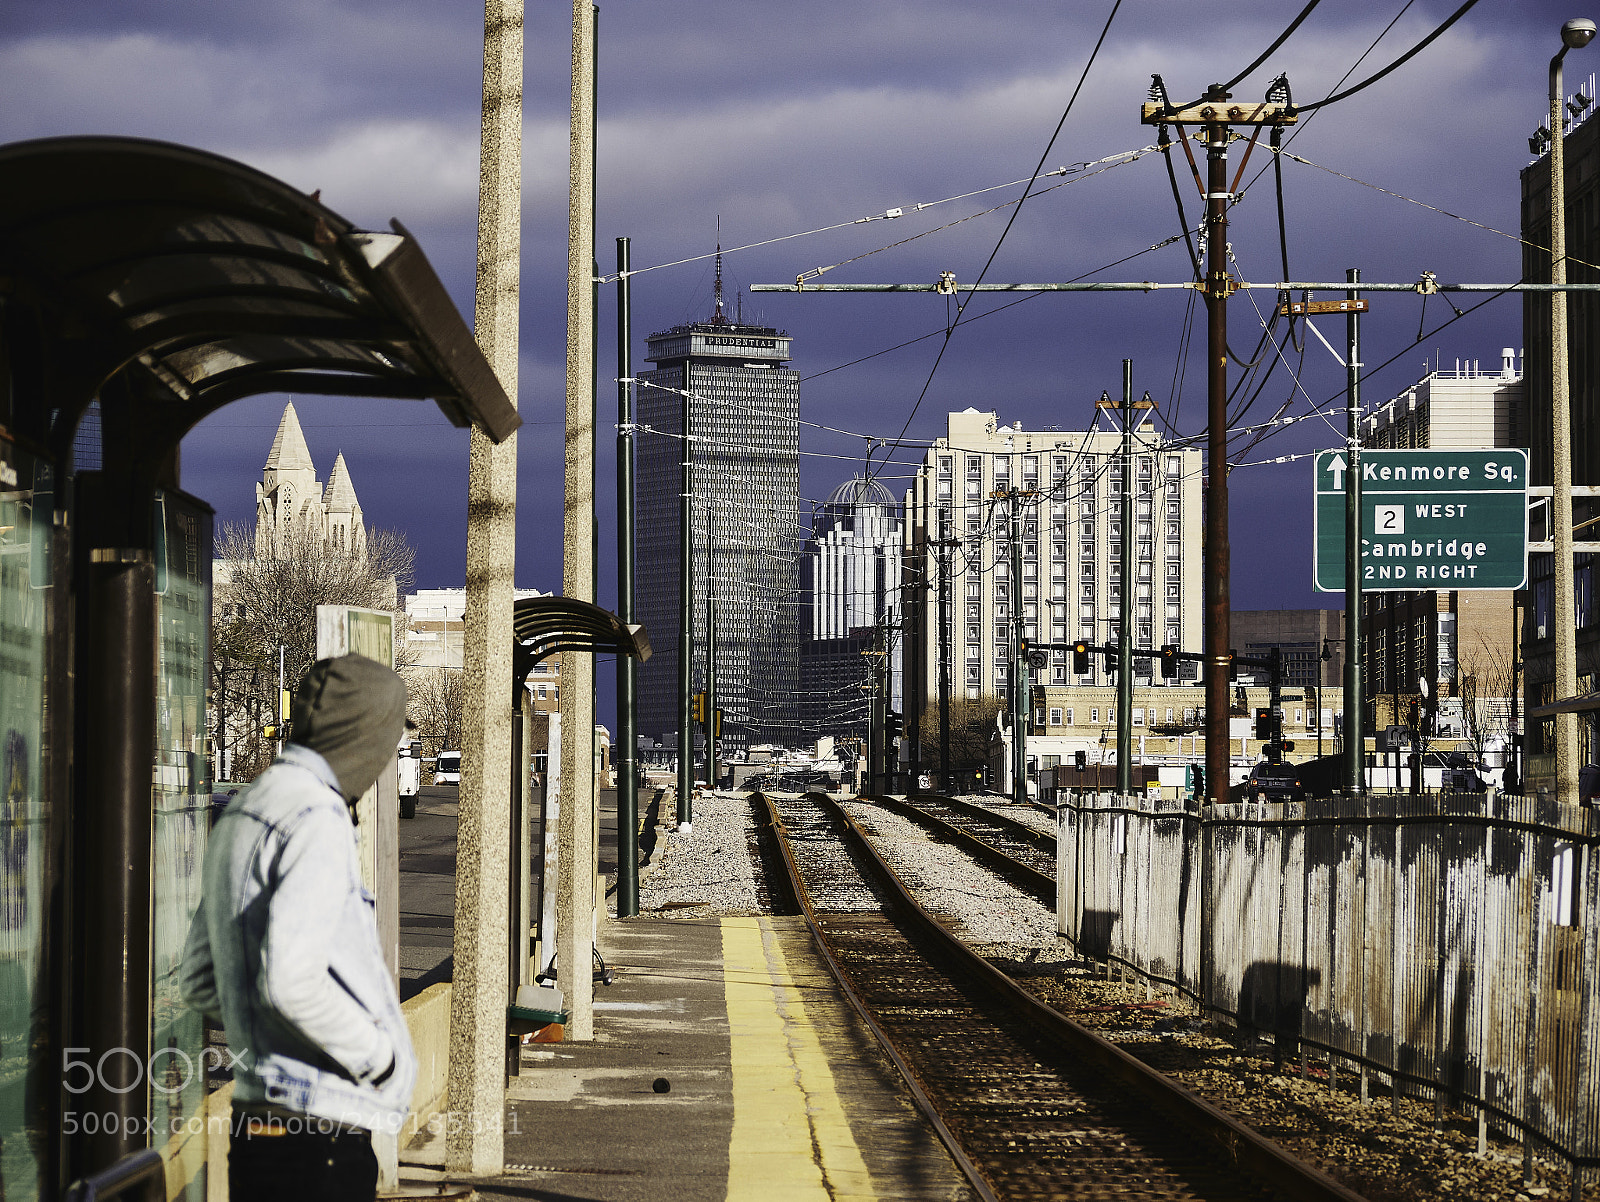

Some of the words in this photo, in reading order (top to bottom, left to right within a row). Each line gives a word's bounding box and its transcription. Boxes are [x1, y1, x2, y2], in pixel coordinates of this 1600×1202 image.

[708, 337, 774, 347] PRUDENTIAL
[1363, 462, 1470, 481] Kenmore
[1484, 461, 1518, 483] Sq.
[1383, 510, 1396, 529] 2
[1415, 504, 1467, 518] WEST
[1364, 565, 1407, 580] 2ND
[1416, 565, 1478, 580] RIGHT
